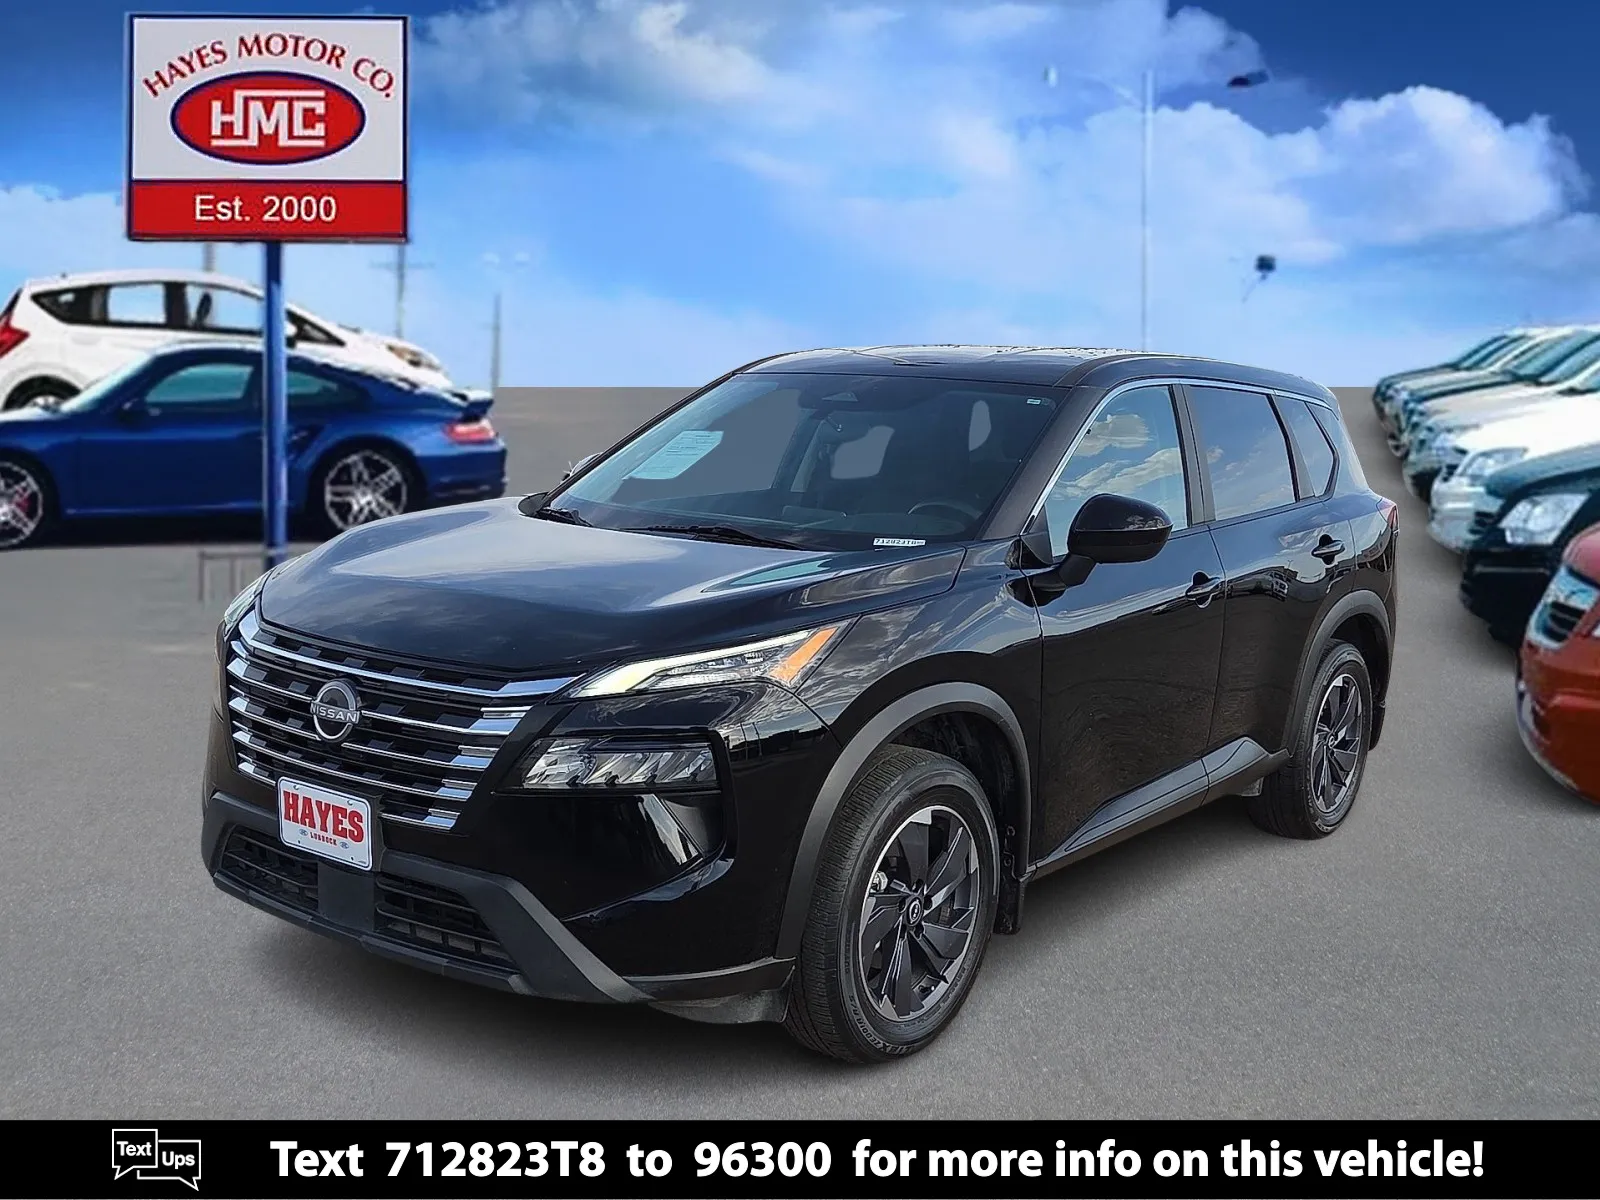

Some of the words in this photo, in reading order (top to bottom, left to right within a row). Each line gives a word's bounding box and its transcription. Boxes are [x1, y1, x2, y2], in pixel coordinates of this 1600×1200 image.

[142, 40, 228, 97] HAYES
[238, 33, 347, 70] MOTOR
[352, 57, 394, 98] CO.
[210, 89, 326, 147] HMC
[194, 194, 250, 222] Est.
[262, 195, 337, 222] 2000
[310, 701, 357, 722] NISSAN
[283, 790, 364, 843] HAYES
